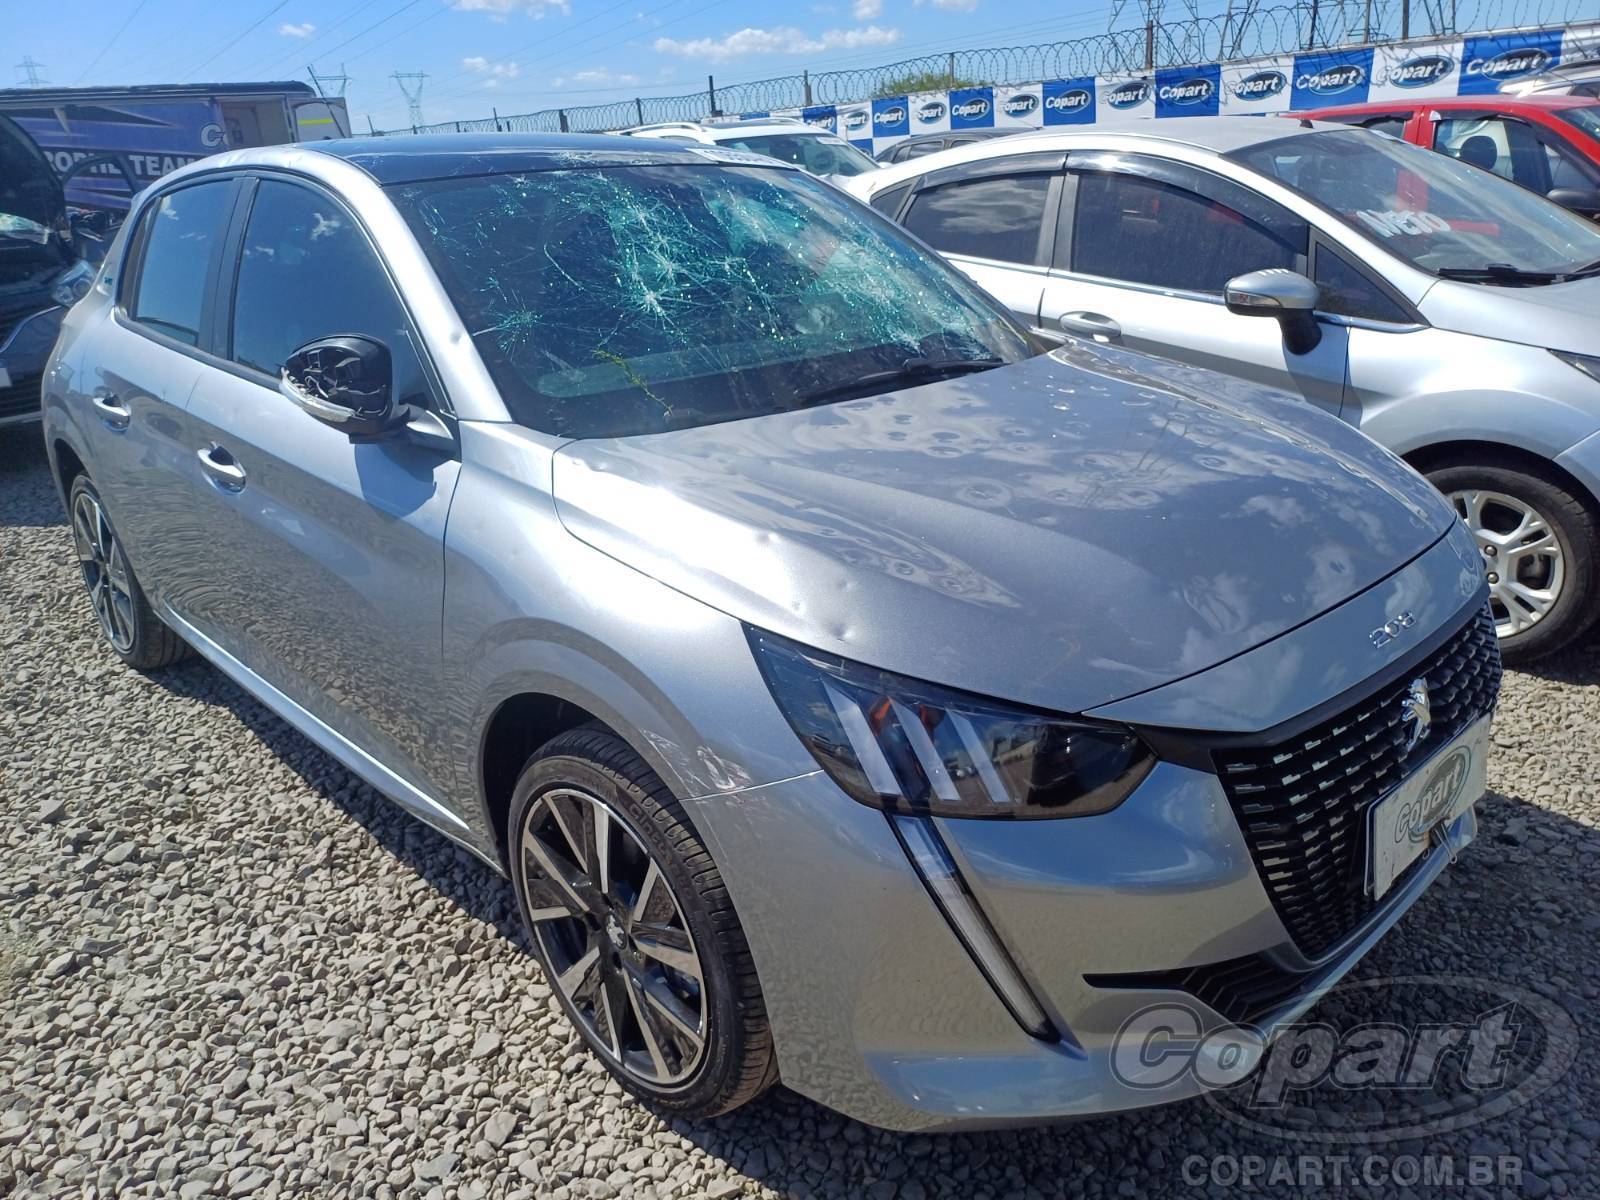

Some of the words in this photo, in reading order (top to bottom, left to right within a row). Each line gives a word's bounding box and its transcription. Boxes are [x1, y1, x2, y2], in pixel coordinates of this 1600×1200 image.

[1377, 61, 1445, 83] Copart
[1466, 53, 1543, 76] Copart
[1225, 76, 1278, 96] Copart
[1296, 69, 1358, 90] Copart
[1045, 93, 1086, 109] Copart
[1160, 83, 1208, 99] Copart
[873, 110, 903, 123] Copart
[951, 101, 986, 117] Copart
[1369, 611, 1416, 649] 208
[1395, 758, 1461, 843] Copart
